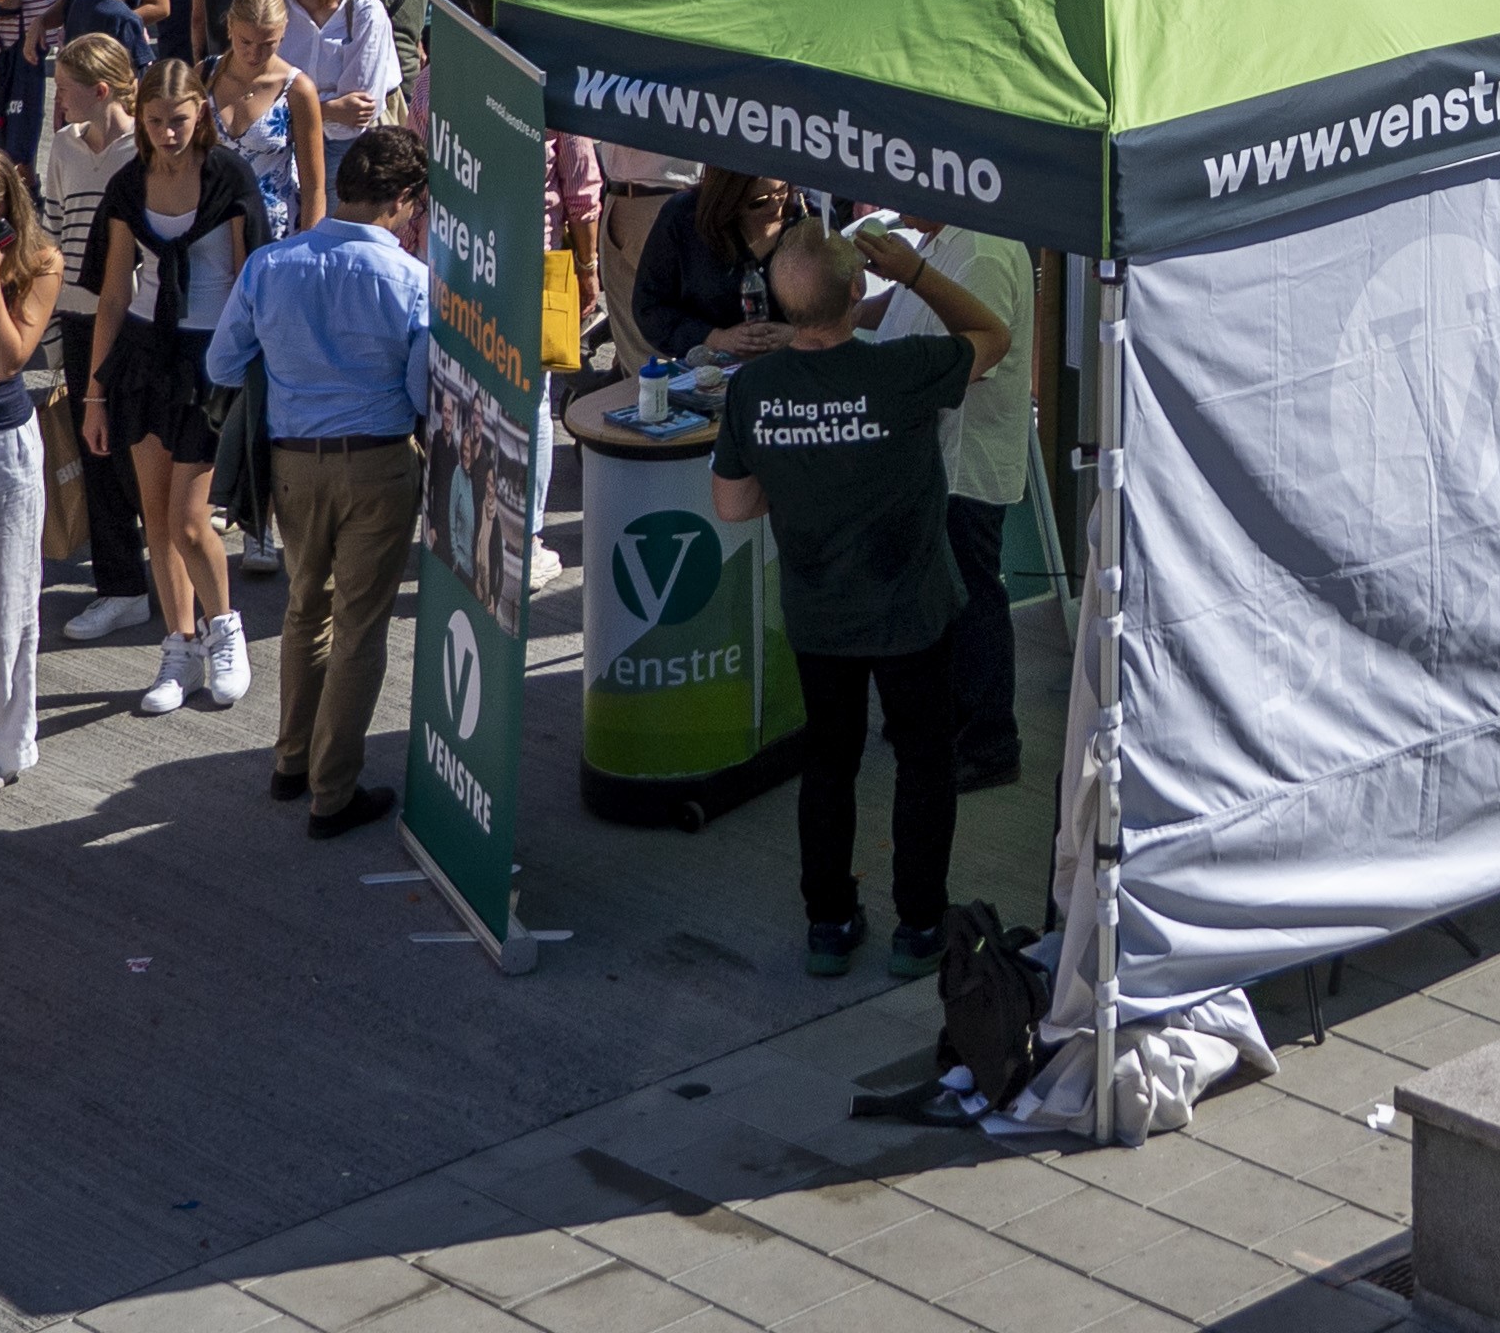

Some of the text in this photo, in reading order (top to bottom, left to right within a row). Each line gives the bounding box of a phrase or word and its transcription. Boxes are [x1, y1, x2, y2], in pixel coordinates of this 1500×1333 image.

[431, 110, 482, 195] Vi tar
[573, 65, 1003, 205] www.venstre.no
[471, 226, 498, 288] på
[754, 417, 890, 446] framtida.
[760, 396, 866, 421] På lag med
[425, 721, 493, 836] VENSTRE
